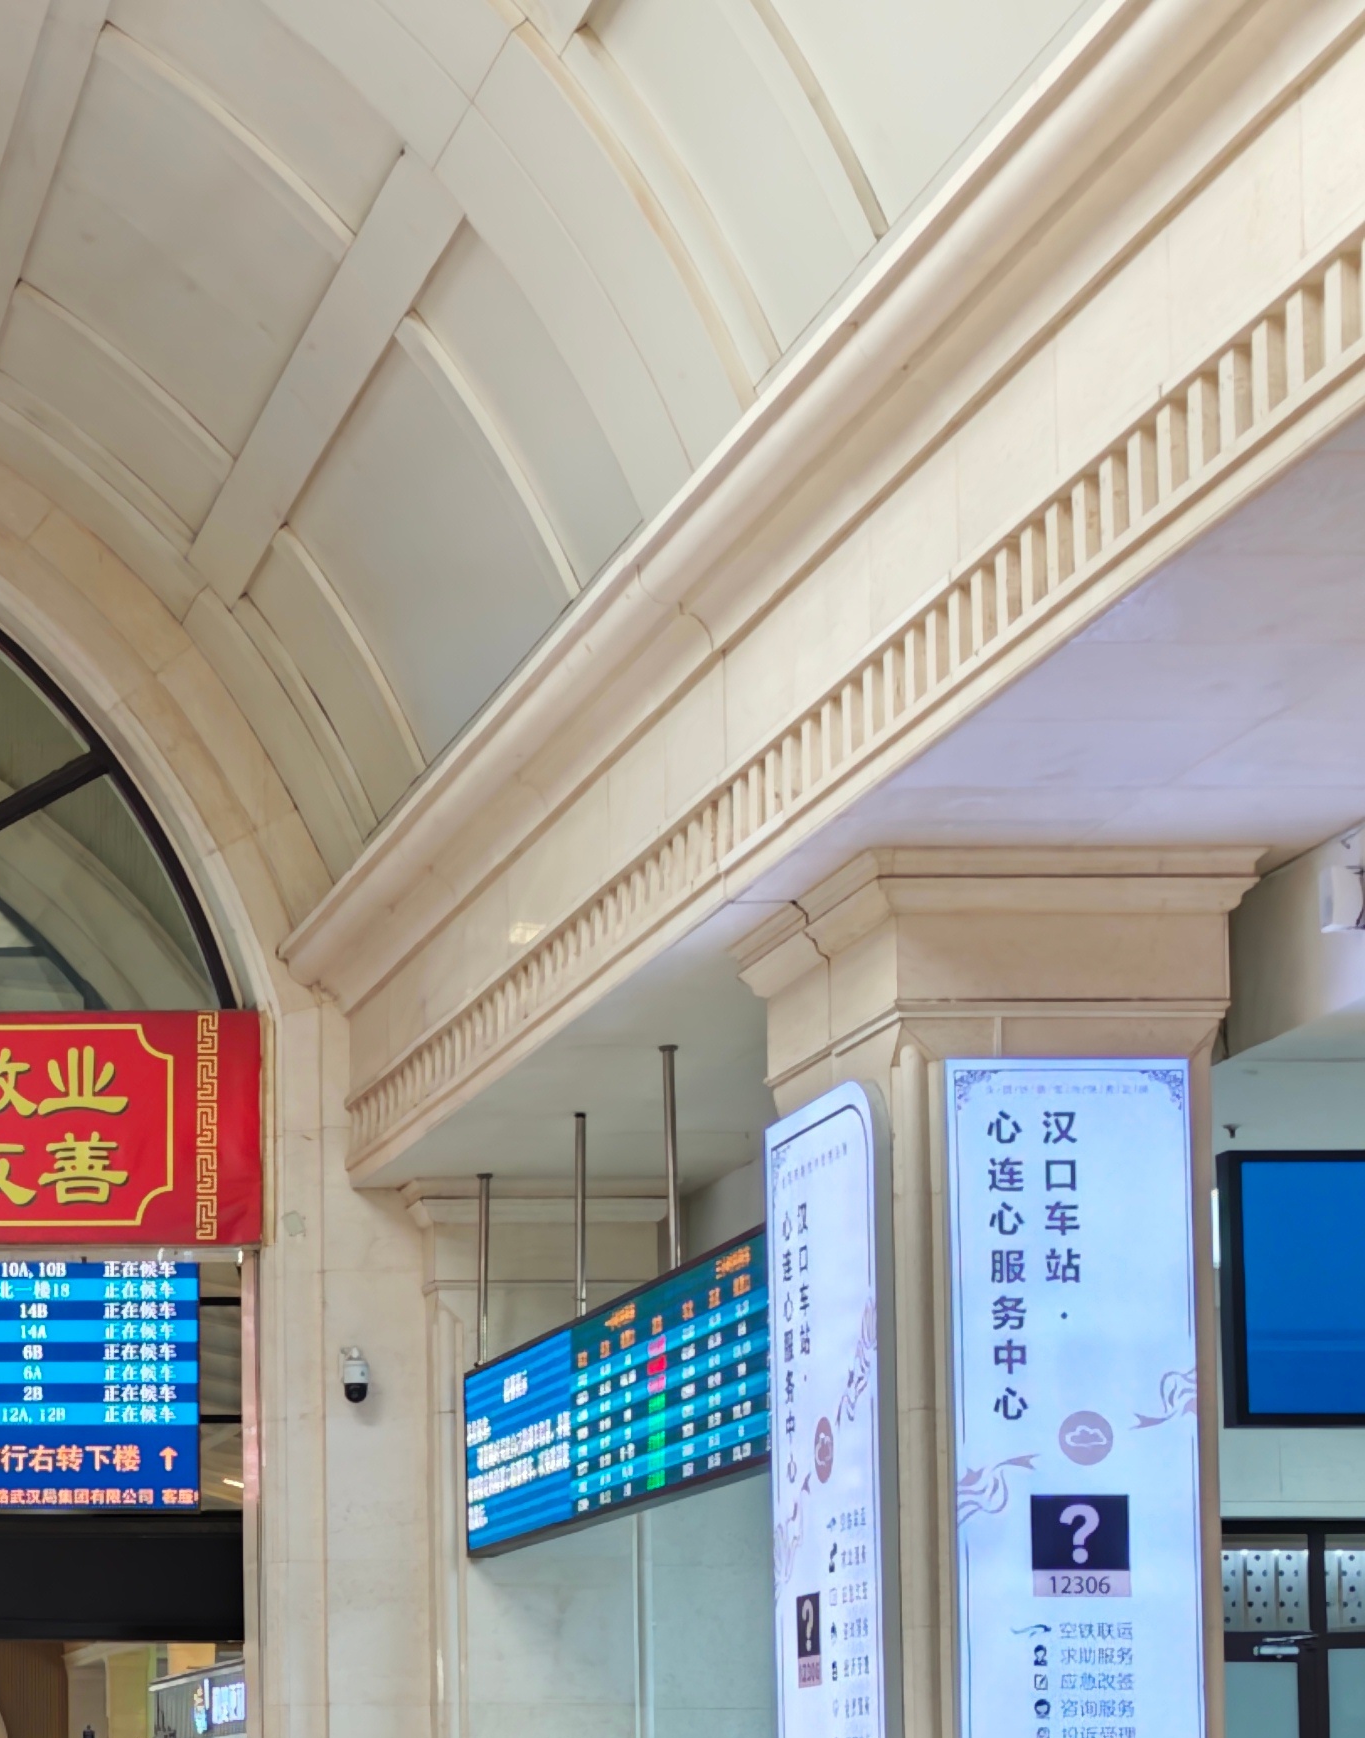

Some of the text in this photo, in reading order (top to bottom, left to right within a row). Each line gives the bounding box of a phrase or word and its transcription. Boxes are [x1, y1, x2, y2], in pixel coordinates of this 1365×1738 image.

[103, 1261, 177, 1279] 正在候车
[987, 1111, 1029, 1421] 心连心服务中心
[19, 1303, 48, 1320] 14B
[103, 1303, 177, 1320] 正在候车
[19, 1323, 48, 1341] 14A
[22, 1344, 43, 1361] 6B
[103, 1344, 177, 1361] 正在候车
[22, 1364, 42, 1382] 6A
[22, 1385, 43, 1403] 2B
[103, 1385, 177, 1403] 正在候车
[1049, 1576, 1111, 1595] 12306
[1060, 1647, 1133, 1665] 求助服务
[1060, 1672, 1135, 1690] 应急改签
[1060, 1699, 1135, 1717] 咨询服务
